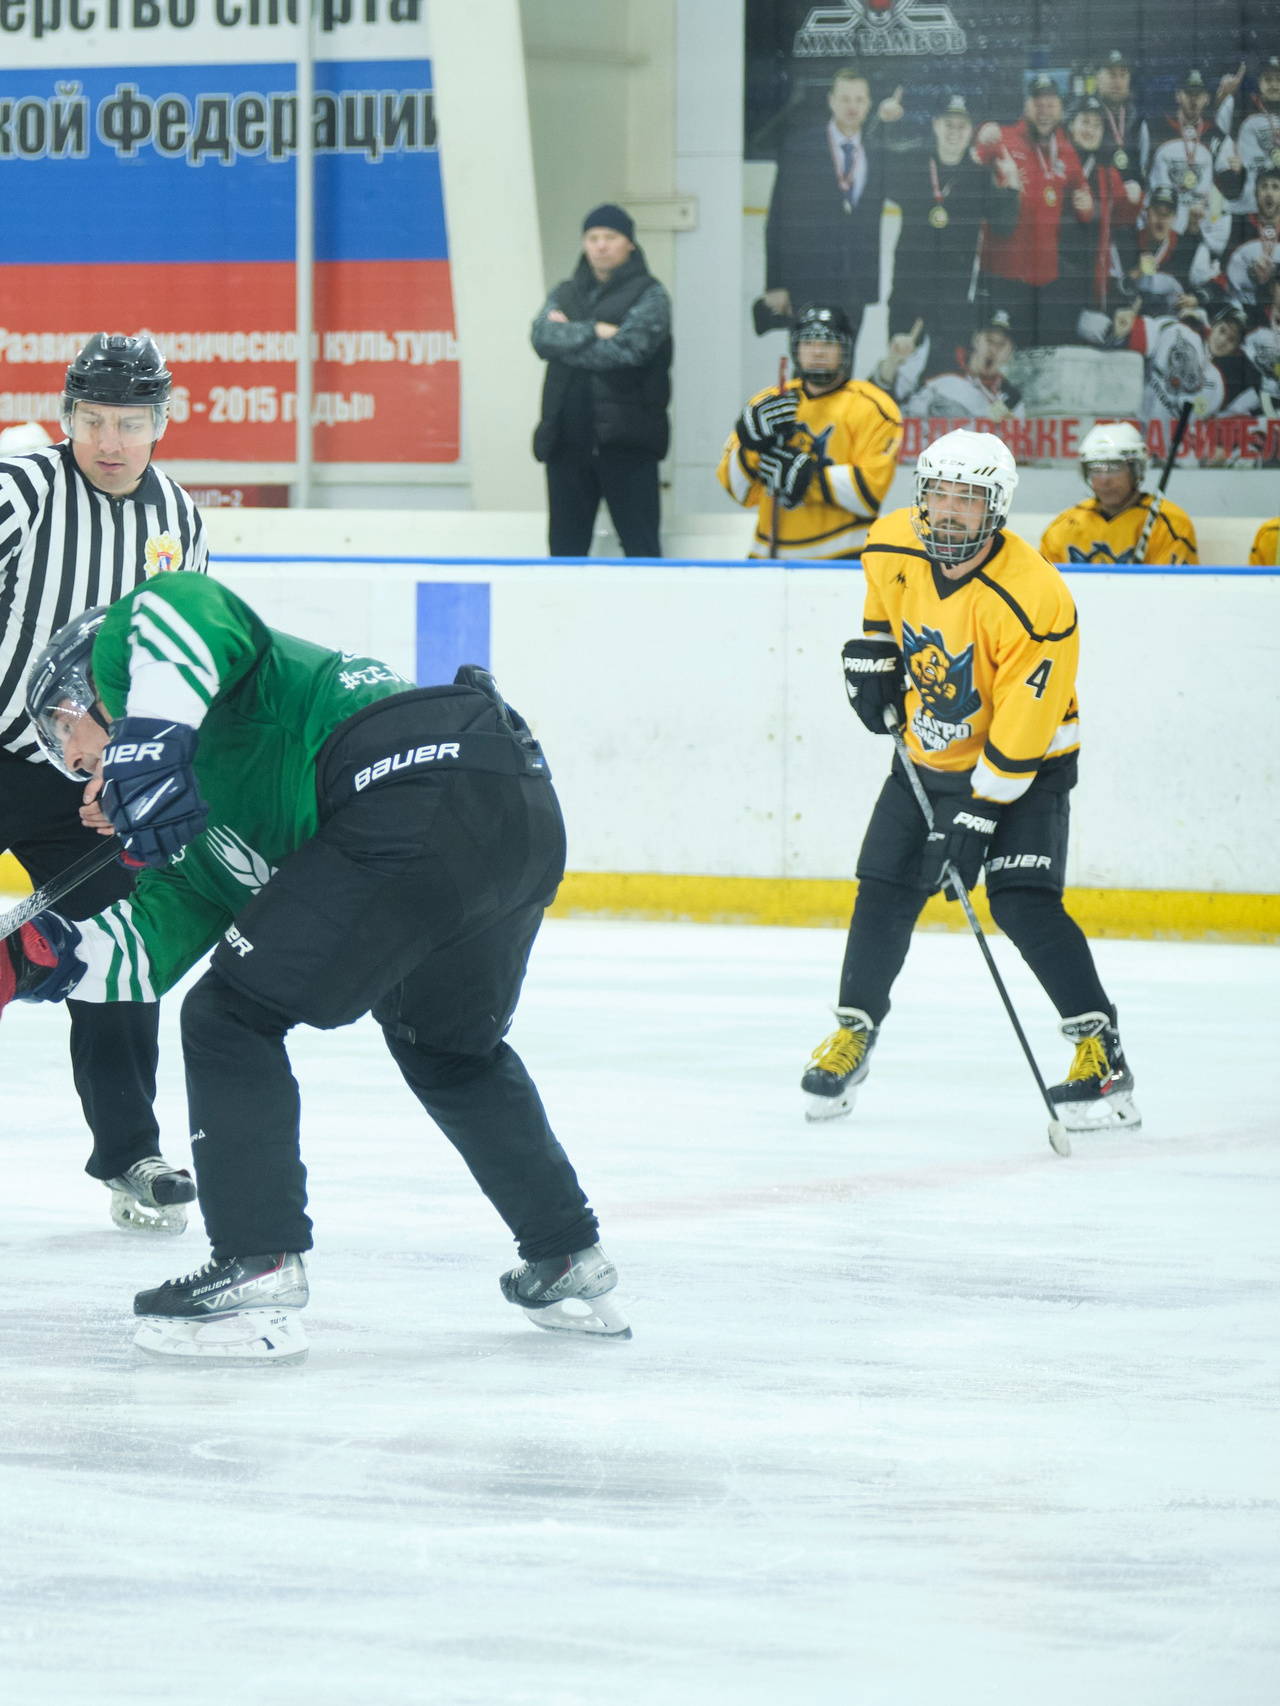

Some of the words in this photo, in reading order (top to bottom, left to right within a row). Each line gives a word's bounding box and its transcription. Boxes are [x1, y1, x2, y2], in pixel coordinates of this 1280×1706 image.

[208, 385, 278, 423] 2015
[281, 391, 376, 428] гды»
[844, 656, 897, 673] PRIME
[1025, 658, 1055, 700] 4
[354, 742, 461, 792] BAUER
[192, 1277, 232, 1298] BAUER
